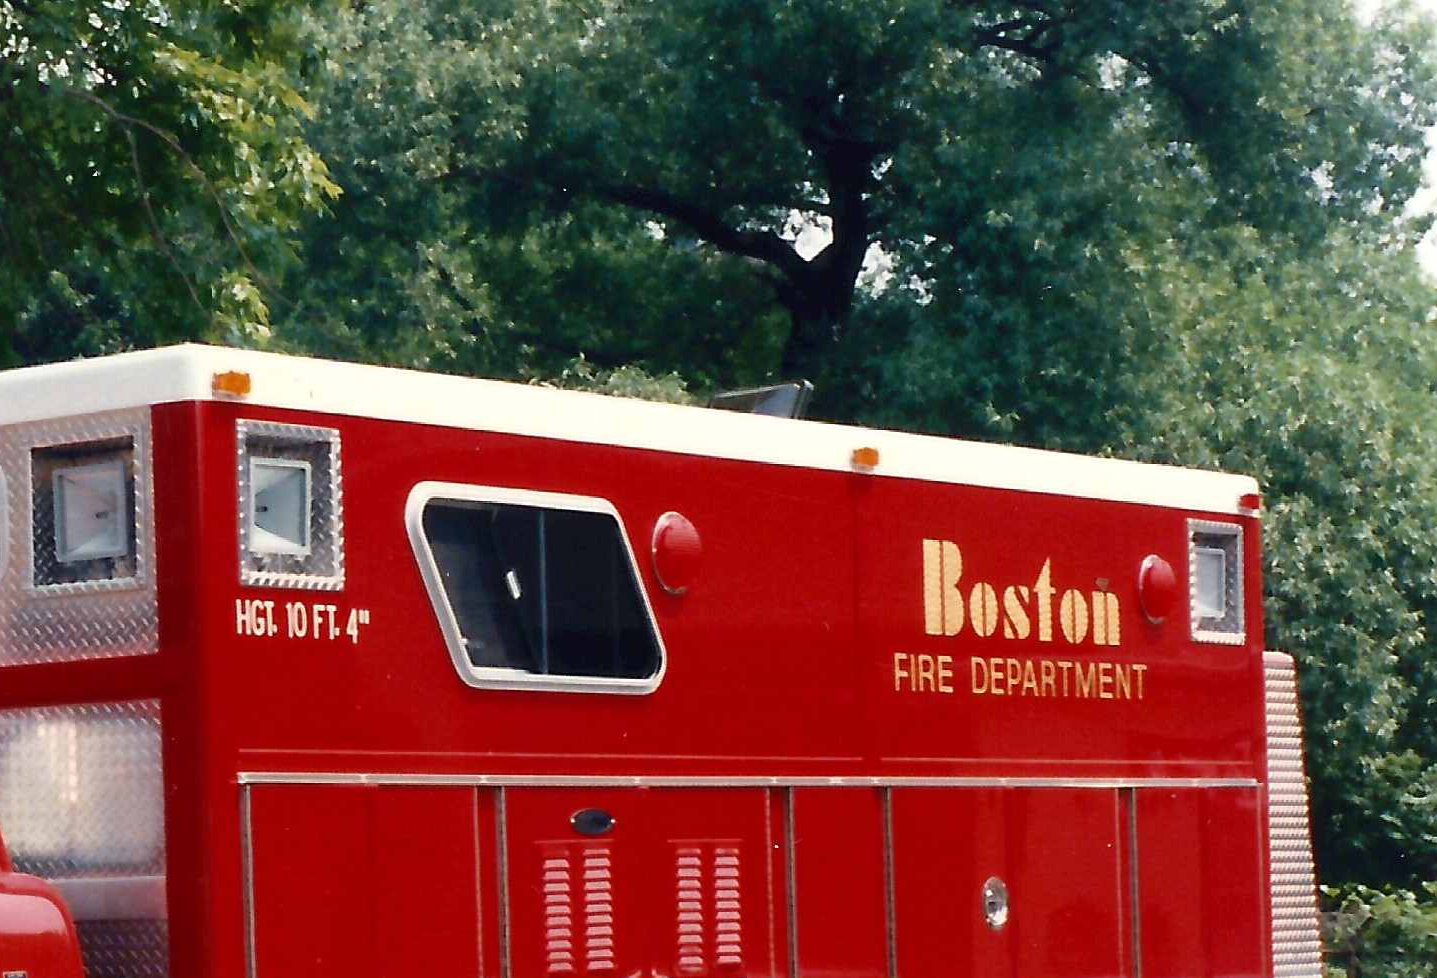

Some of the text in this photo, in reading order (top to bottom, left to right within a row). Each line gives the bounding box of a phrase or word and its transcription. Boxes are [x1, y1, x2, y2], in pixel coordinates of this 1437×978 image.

[922, 538, 1121, 646] Boston
[236, 599, 370, 644] HGT. 10 FT. 4"
[894, 652, 1148, 700] FIRE DEPARTMENT
